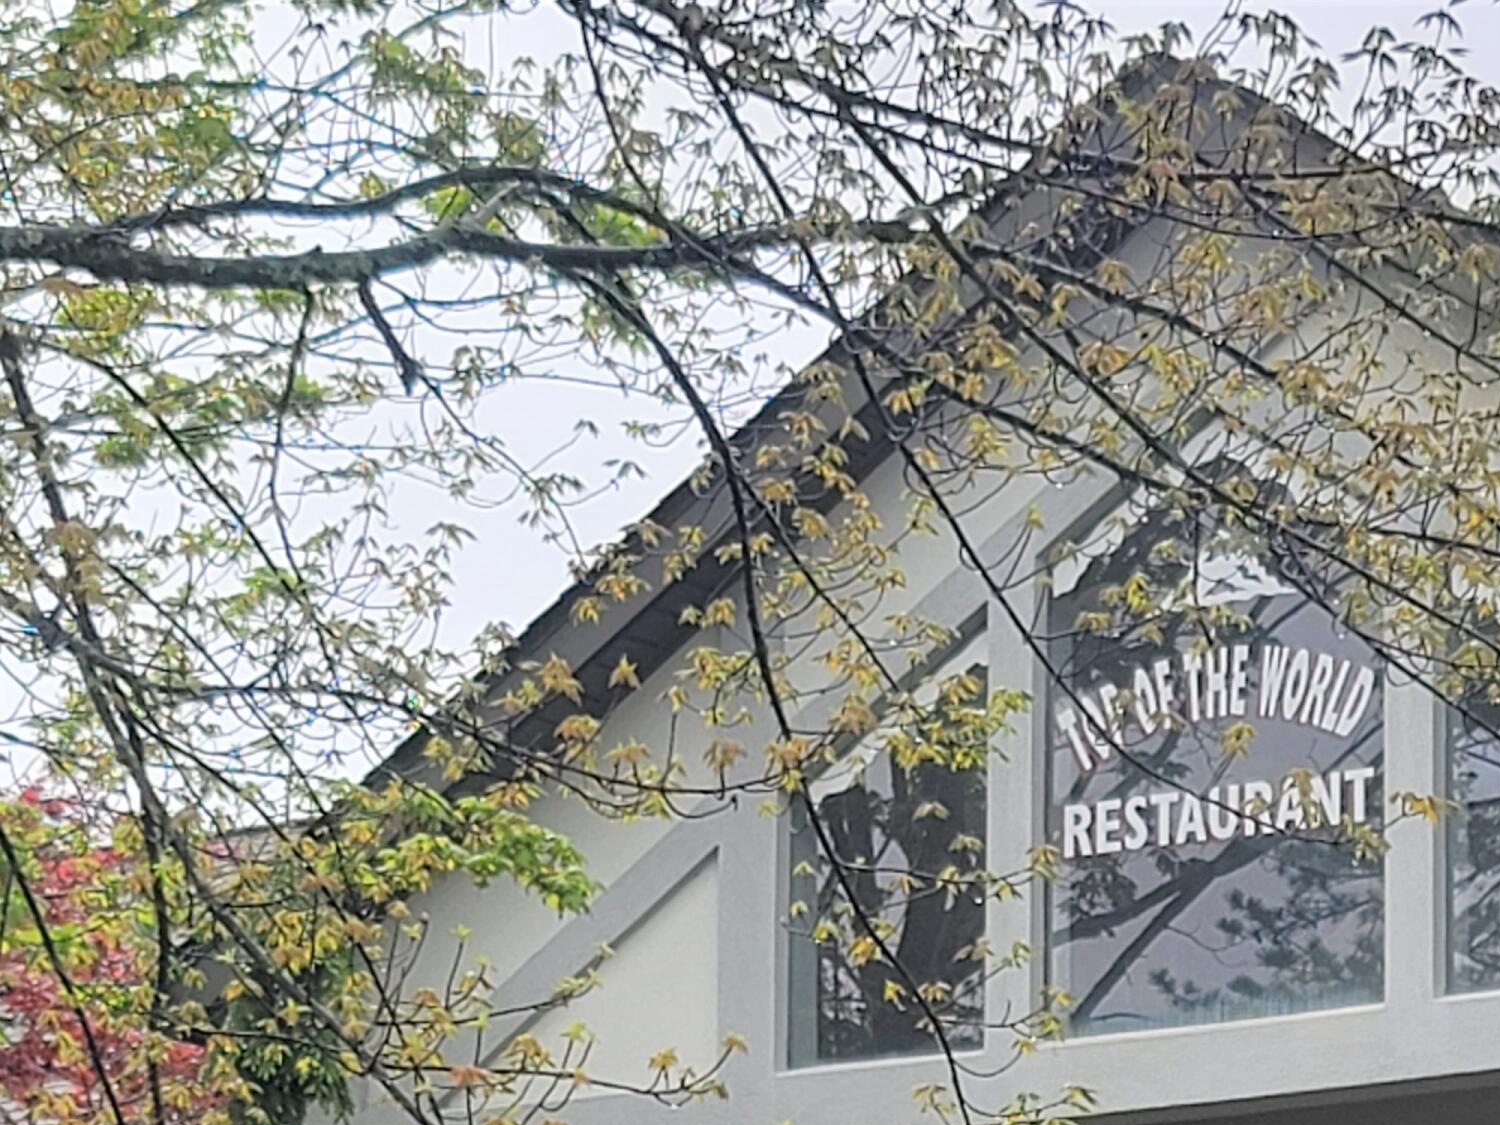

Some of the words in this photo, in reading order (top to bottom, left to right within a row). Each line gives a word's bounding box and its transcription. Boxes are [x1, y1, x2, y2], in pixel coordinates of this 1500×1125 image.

[1133, 658, 1174, 735] OF
[1183, 644, 1249, 723] THE
[1259, 644, 1376, 737] WORLD
[1063, 767, 1375, 859] RESTAURANT
